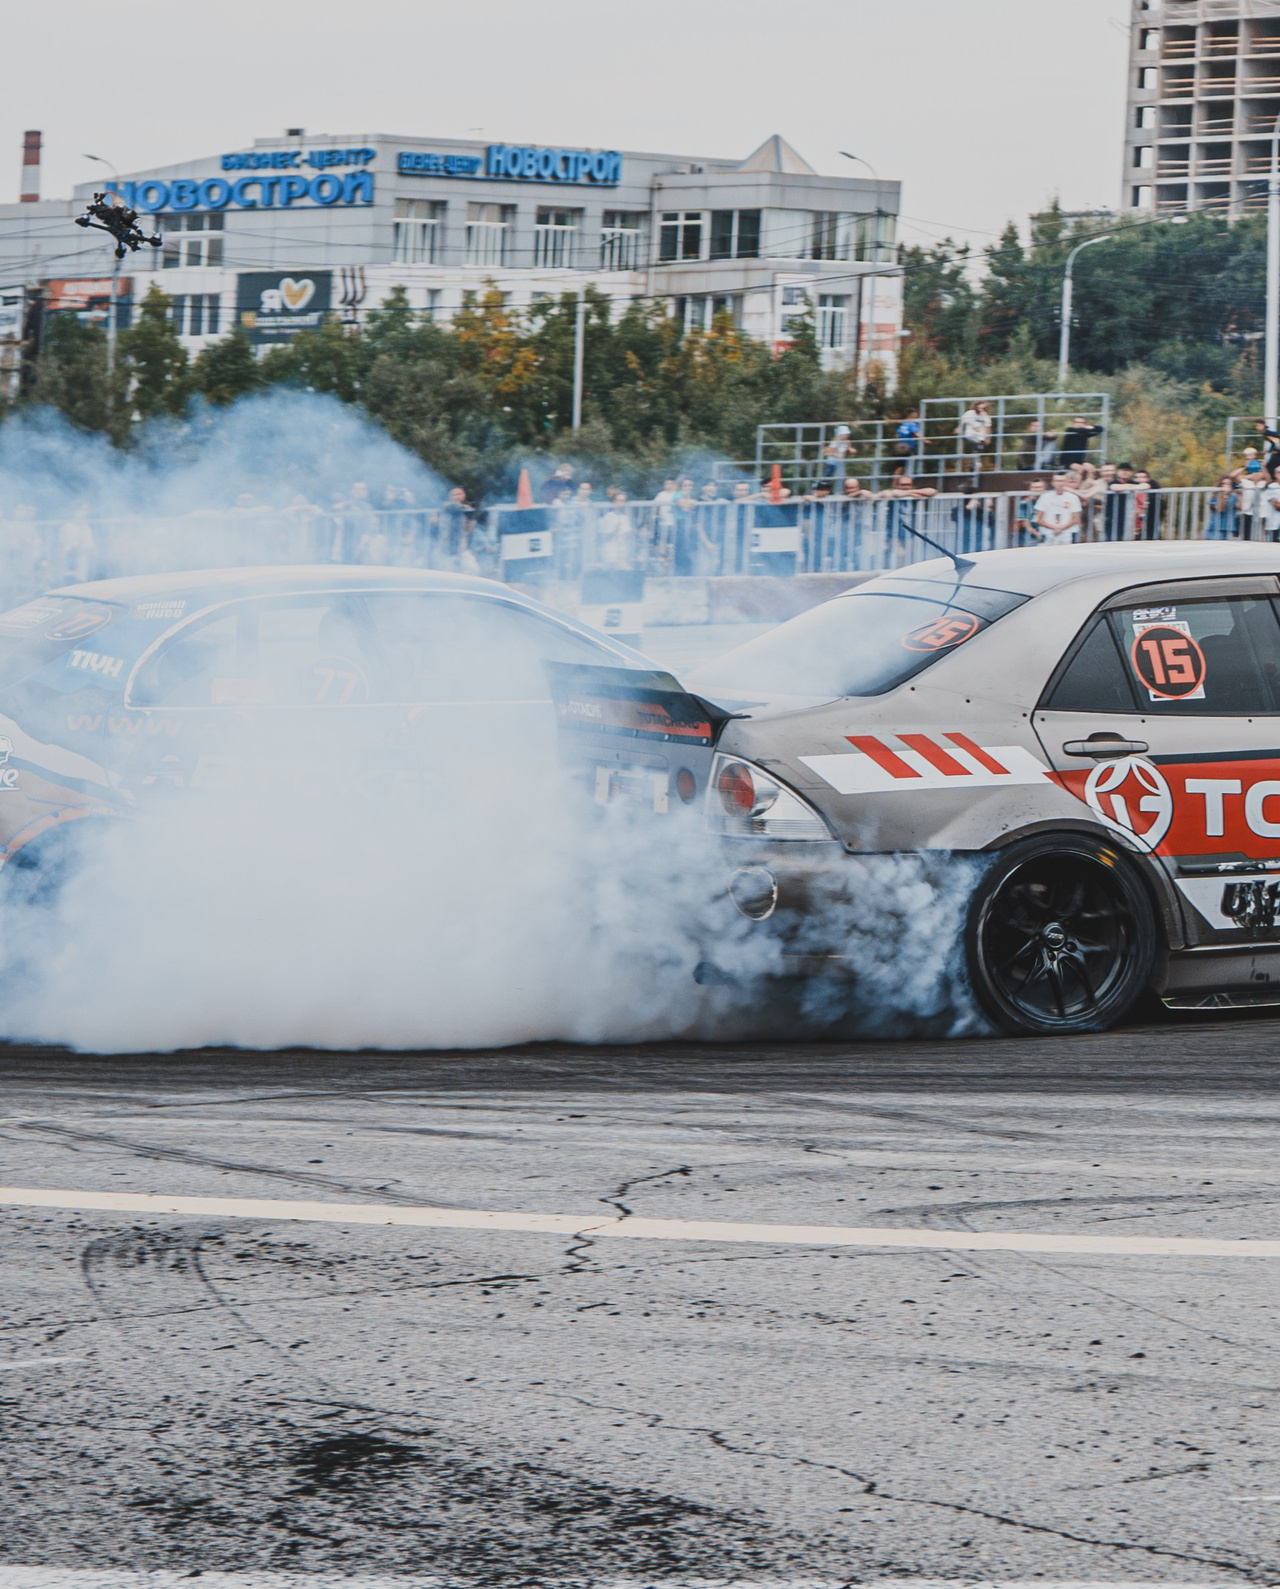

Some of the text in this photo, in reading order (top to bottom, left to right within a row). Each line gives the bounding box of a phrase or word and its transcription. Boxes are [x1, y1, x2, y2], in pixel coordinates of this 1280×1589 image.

[221, 148, 375, 170] БИЗНЕС-ЦЕНТР
[487, 145, 622, 183] НОВОСТРОЙ
[105, 170, 374, 211] НОВОСТРОЙ
[1141, 638, 1197, 684] 15
